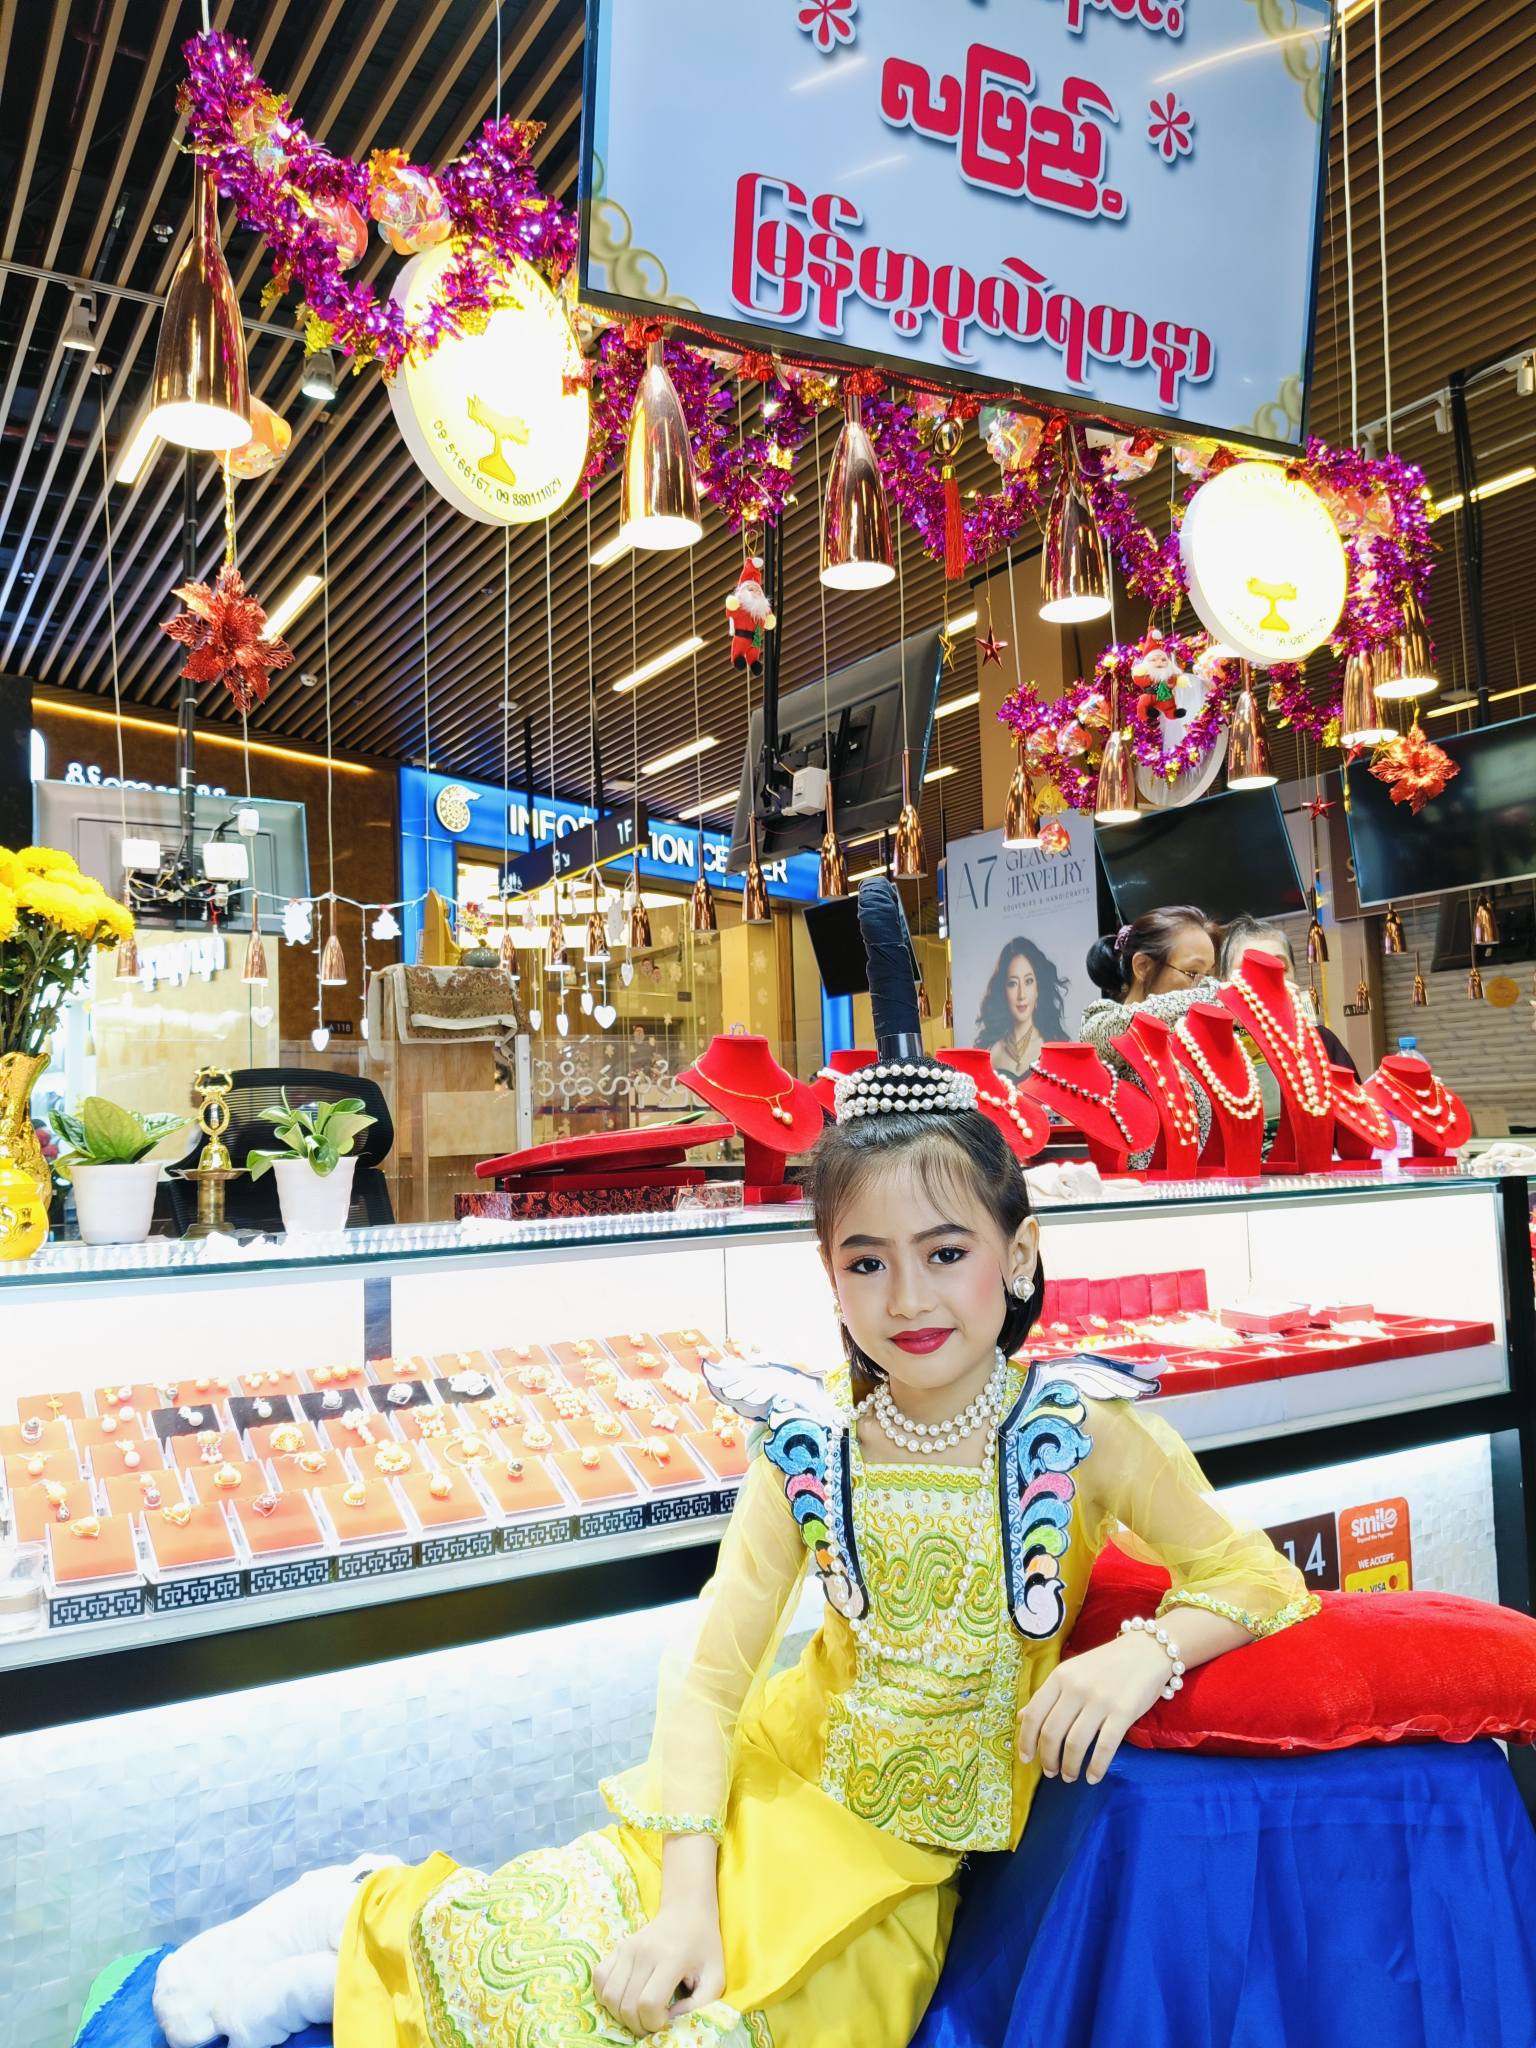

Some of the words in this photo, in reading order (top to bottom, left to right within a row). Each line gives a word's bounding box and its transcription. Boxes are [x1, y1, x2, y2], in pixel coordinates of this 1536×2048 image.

[880, 42, 1125, 217] လပြည့်
[496, 488, 510, 504] 09
[510, 803, 694, 867] INFOION
[703, 842, 789, 884] CEER
[617, 818, 633, 845] 1F
[956, 855, 998, 912] A7
[1007, 861, 1084, 898] JEWELRY
[1351, 1507, 1398, 1538] smile
[1358, 1558, 1370, 1569] WE
[1370, 1552, 1394, 1567] ACCEPT
[1370, 1582, 1386, 1592] VISA
